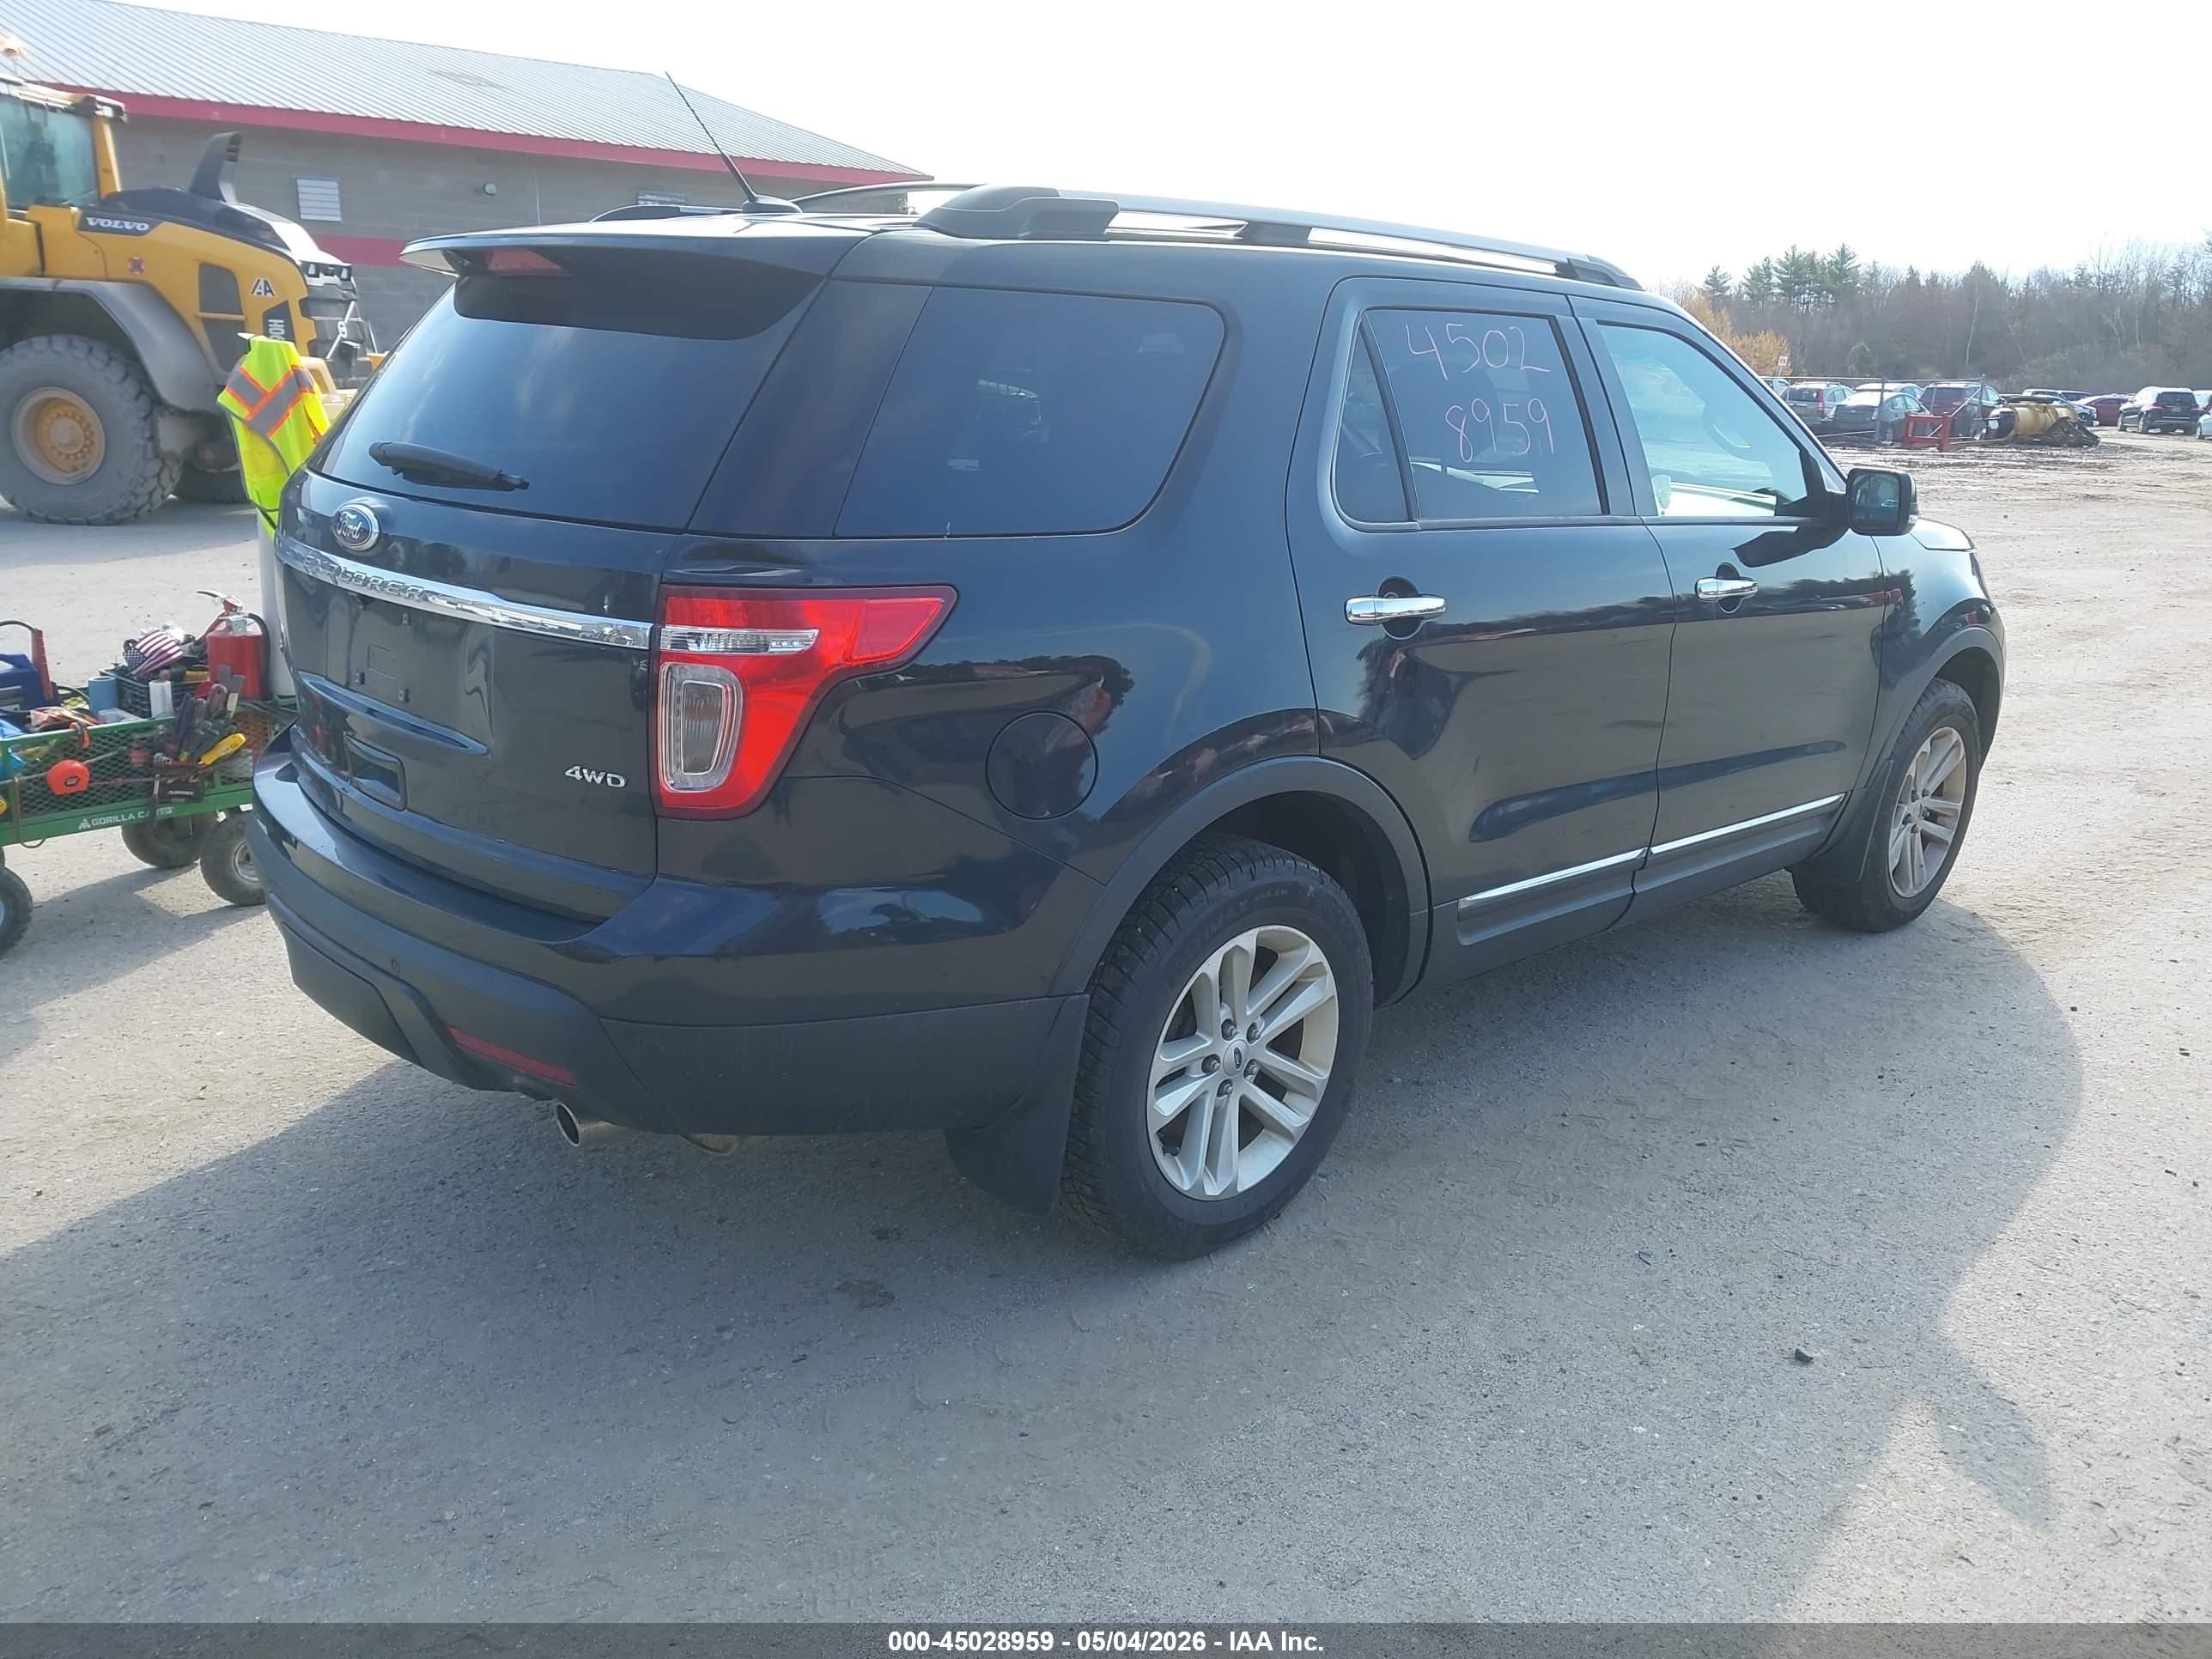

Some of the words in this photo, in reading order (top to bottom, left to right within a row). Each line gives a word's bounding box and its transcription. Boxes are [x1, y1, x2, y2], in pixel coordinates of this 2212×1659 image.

[86, 216, 149, 231] VOLVO
[1405, 323, 1552, 380] 4502
[1445, 398, 1554, 463] 8959
[336, 511, 363, 540] Ford
[564, 765, 626, 787] 4WD
[91, 813, 136, 826] GORILLA
[137, 806, 174, 819] CTS
